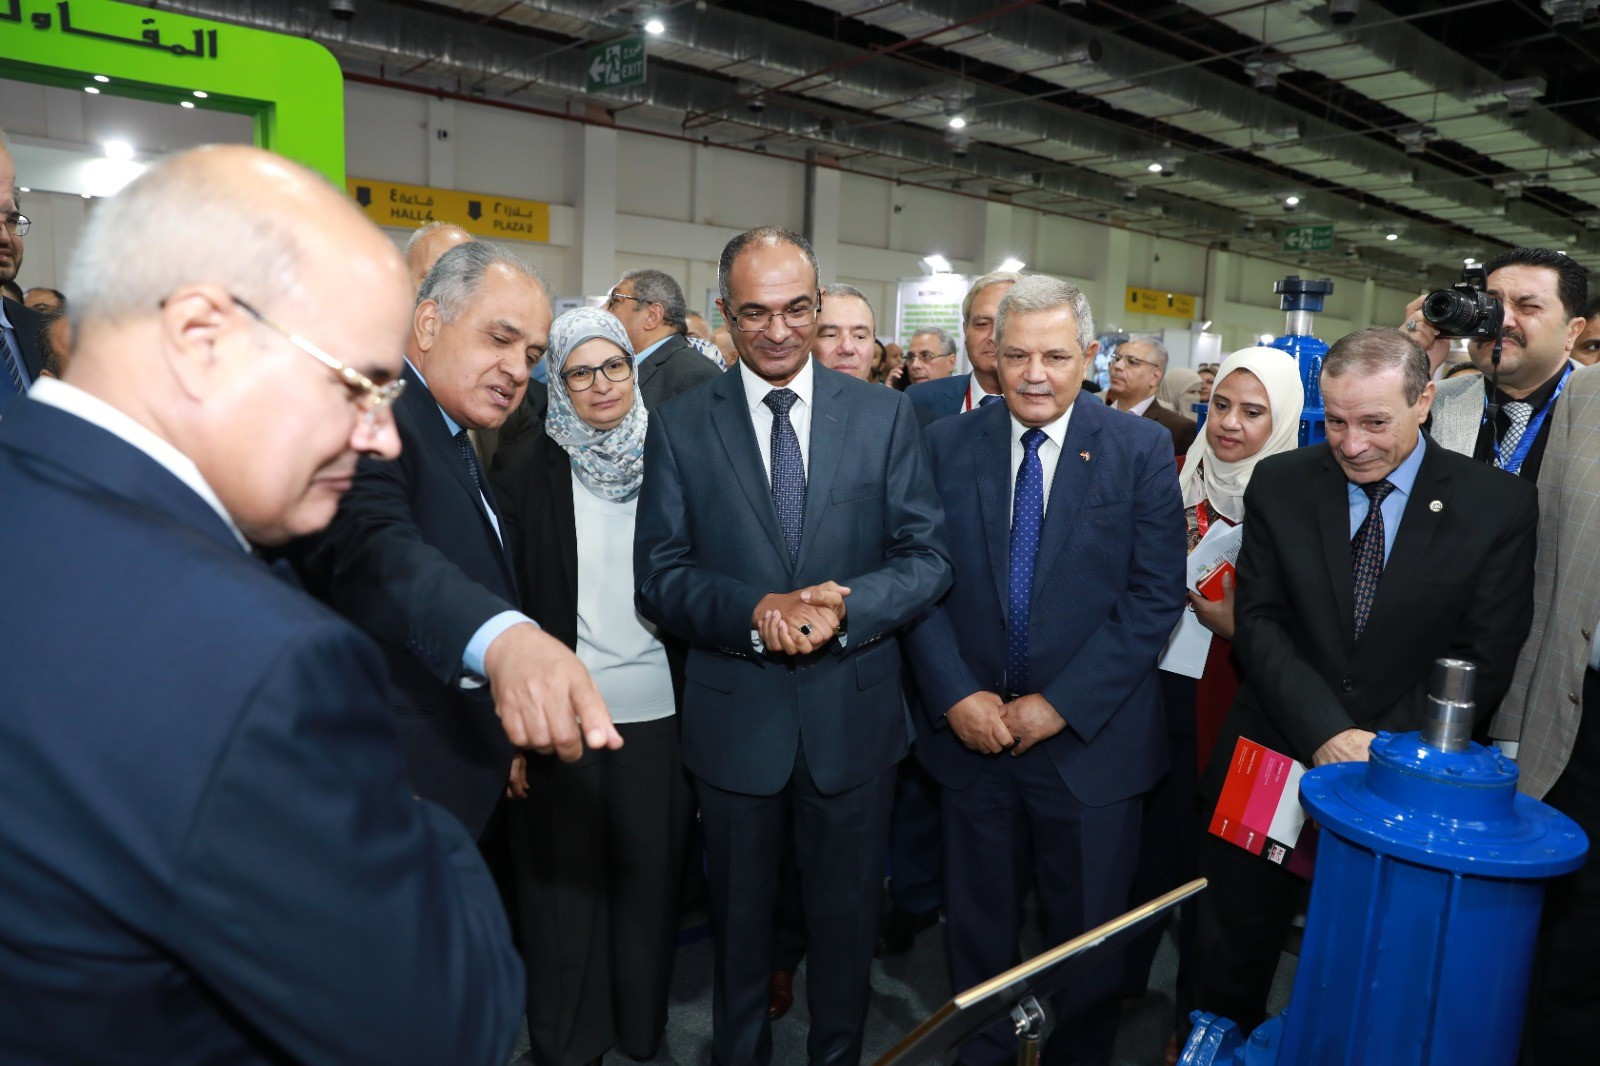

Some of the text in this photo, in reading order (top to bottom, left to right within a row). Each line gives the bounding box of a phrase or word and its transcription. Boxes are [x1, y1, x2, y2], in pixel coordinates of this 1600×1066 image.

[0, 0, 218, 58] المقاول
[622, 61, 642, 79] EXIT
[391, 207, 434, 221] HALL 4
[493, 219, 534, 234] PLAZA 2
